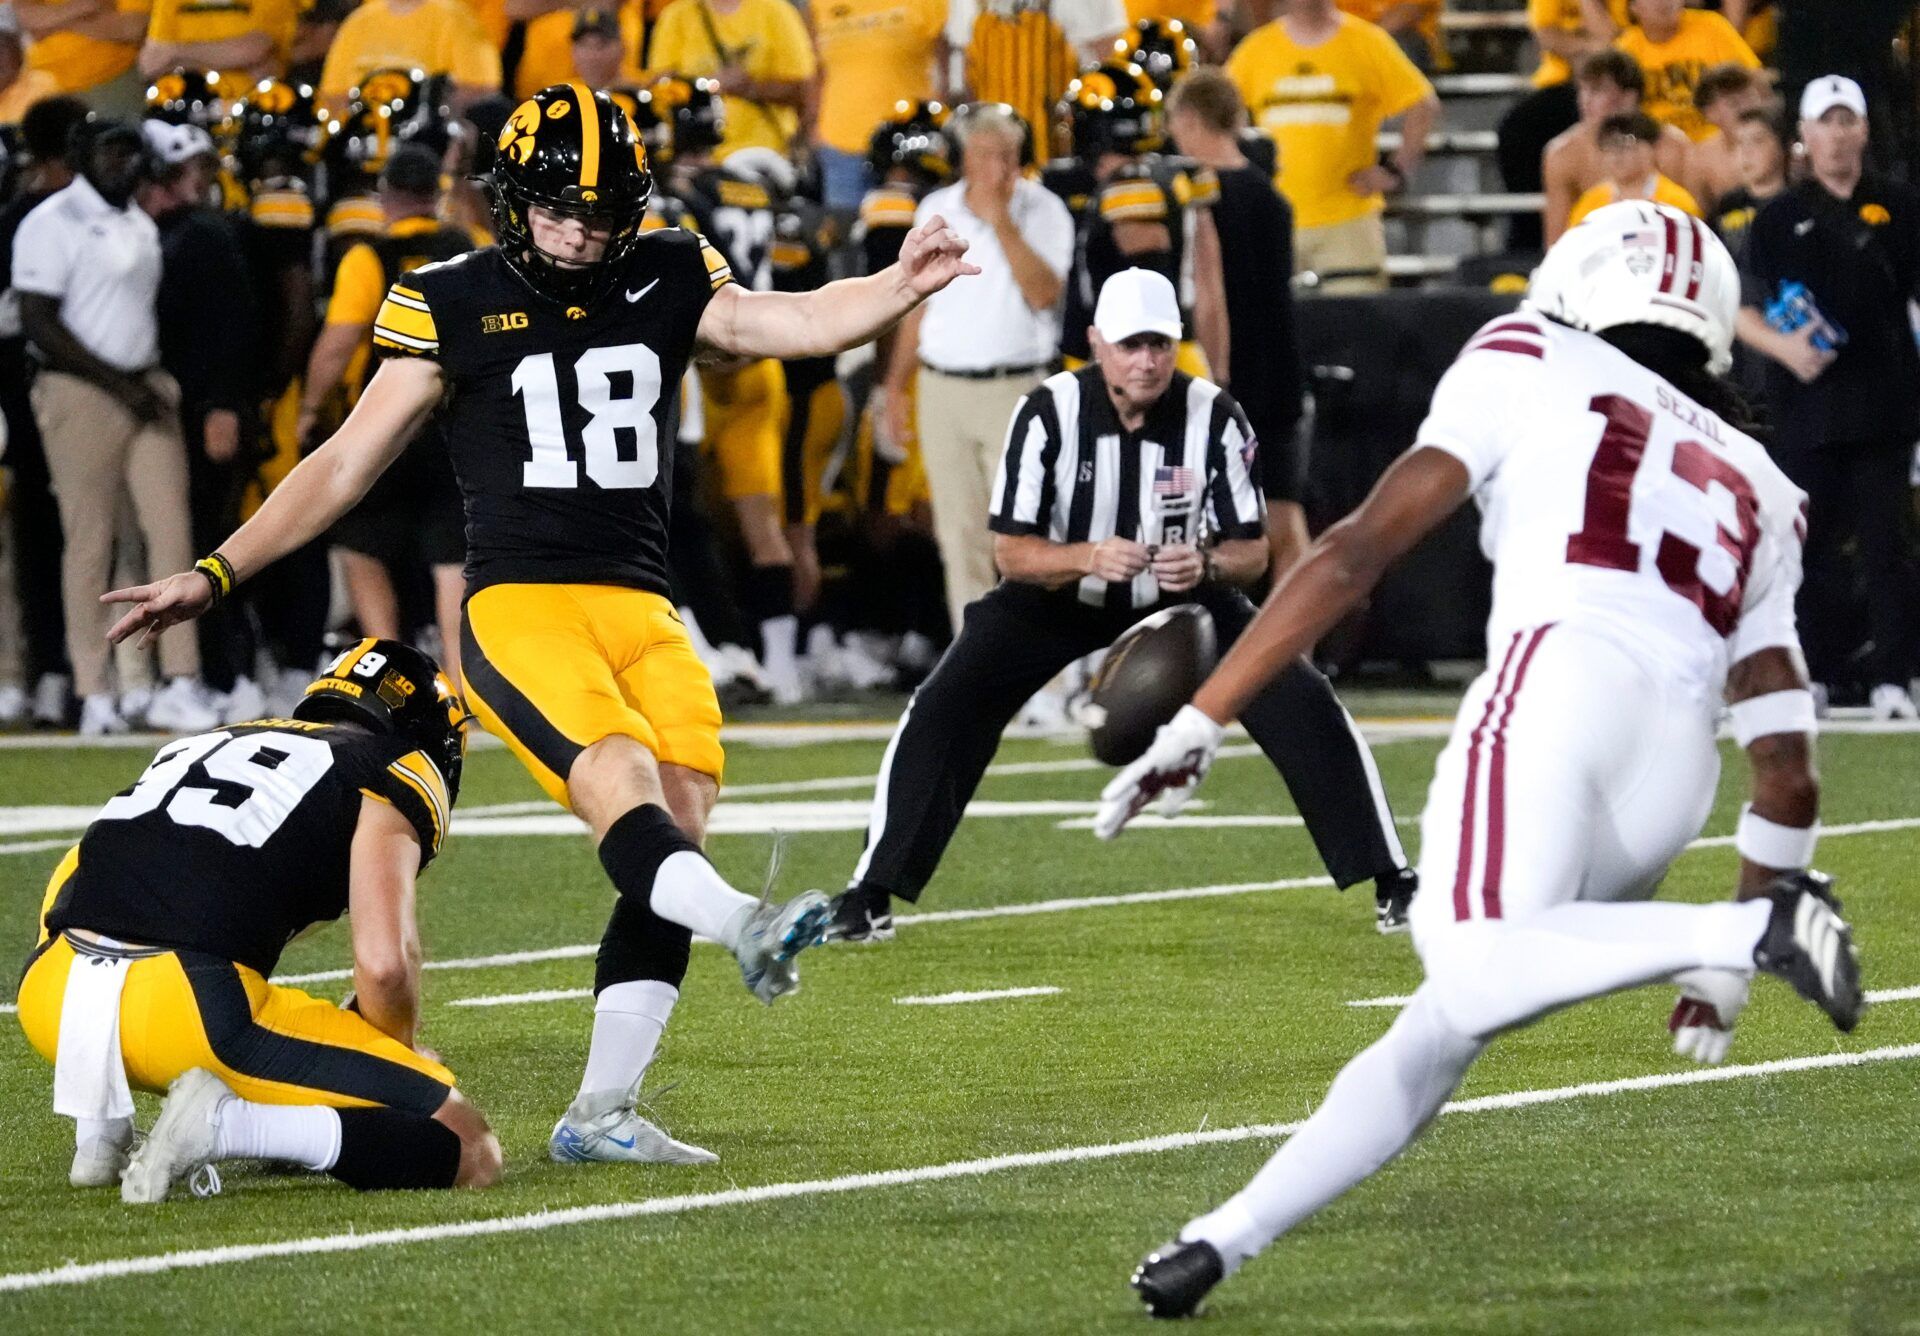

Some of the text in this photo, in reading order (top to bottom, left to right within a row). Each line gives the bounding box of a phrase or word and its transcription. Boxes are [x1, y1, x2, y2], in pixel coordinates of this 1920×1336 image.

[511, 343, 662, 489] 18
[1655, 385, 1727, 447] SEXIL
[1565, 393, 1762, 639] 13
[93, 731, 335, 848] 99
